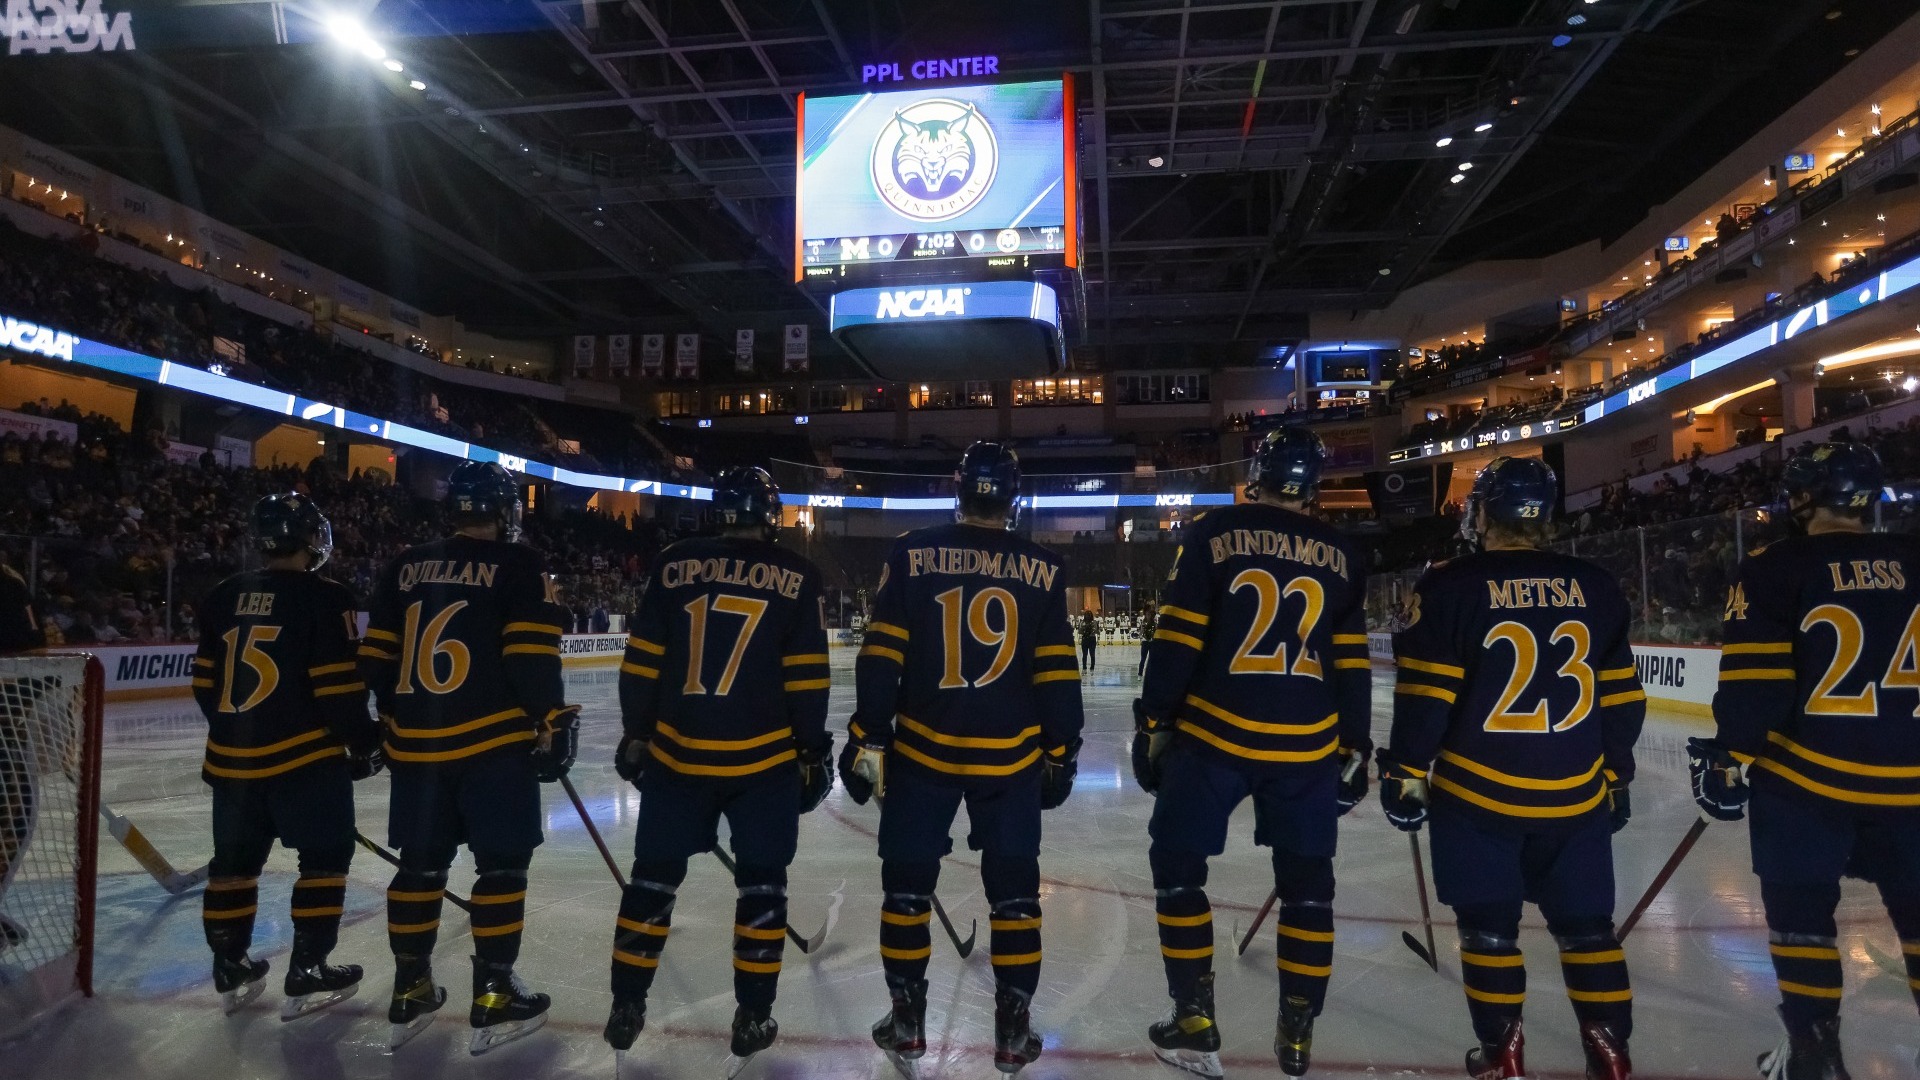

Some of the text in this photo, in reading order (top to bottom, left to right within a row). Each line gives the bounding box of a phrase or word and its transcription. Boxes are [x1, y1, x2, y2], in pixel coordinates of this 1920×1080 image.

[862, 55, 1000, 83] PPL CENTER
[884, 179, 983, 213] QUINNIPIAC
[840, 232, 985, 261] M 0 7:02 0
[913, 249, 938, 257] PERIOD
[988, 258, 1016, 266] PENALTY
[1441, 441, 1453, 453] M
[1478, 432, 1496, 442] 7:02
[976, 482, 992, 494] 19
[1281, 484, 1300, 495] 22
[1850, 494, 1869, 506] 24
[460, 500, 473, 511] 16
[1521, 505, 1540, 518] 23
[263, 540, 276, 549] 15
[399, 560, 499, 592] QUILLAN
[662, 557, 804, 600] CIPOLLONE
[908, 547, 1059, 592] FRIEDMANN
[1828, 559, 1906, 592] LESS
[234, 592, 276, 616] LEE
[1487, 577, 1587, 610] METSA
[934, 585, 1019, 690] 19
[1228, 567, 1325, 682] 22
[395, 599, 471, 695] 16
[569, 638, 596, 654] HOCKEY
[682, 593, 769, 697] 17
[217, 624, 283, 714] 15
[1799, 603, 1920, 718] 24
[1482, 619, 1595, 734] 23
